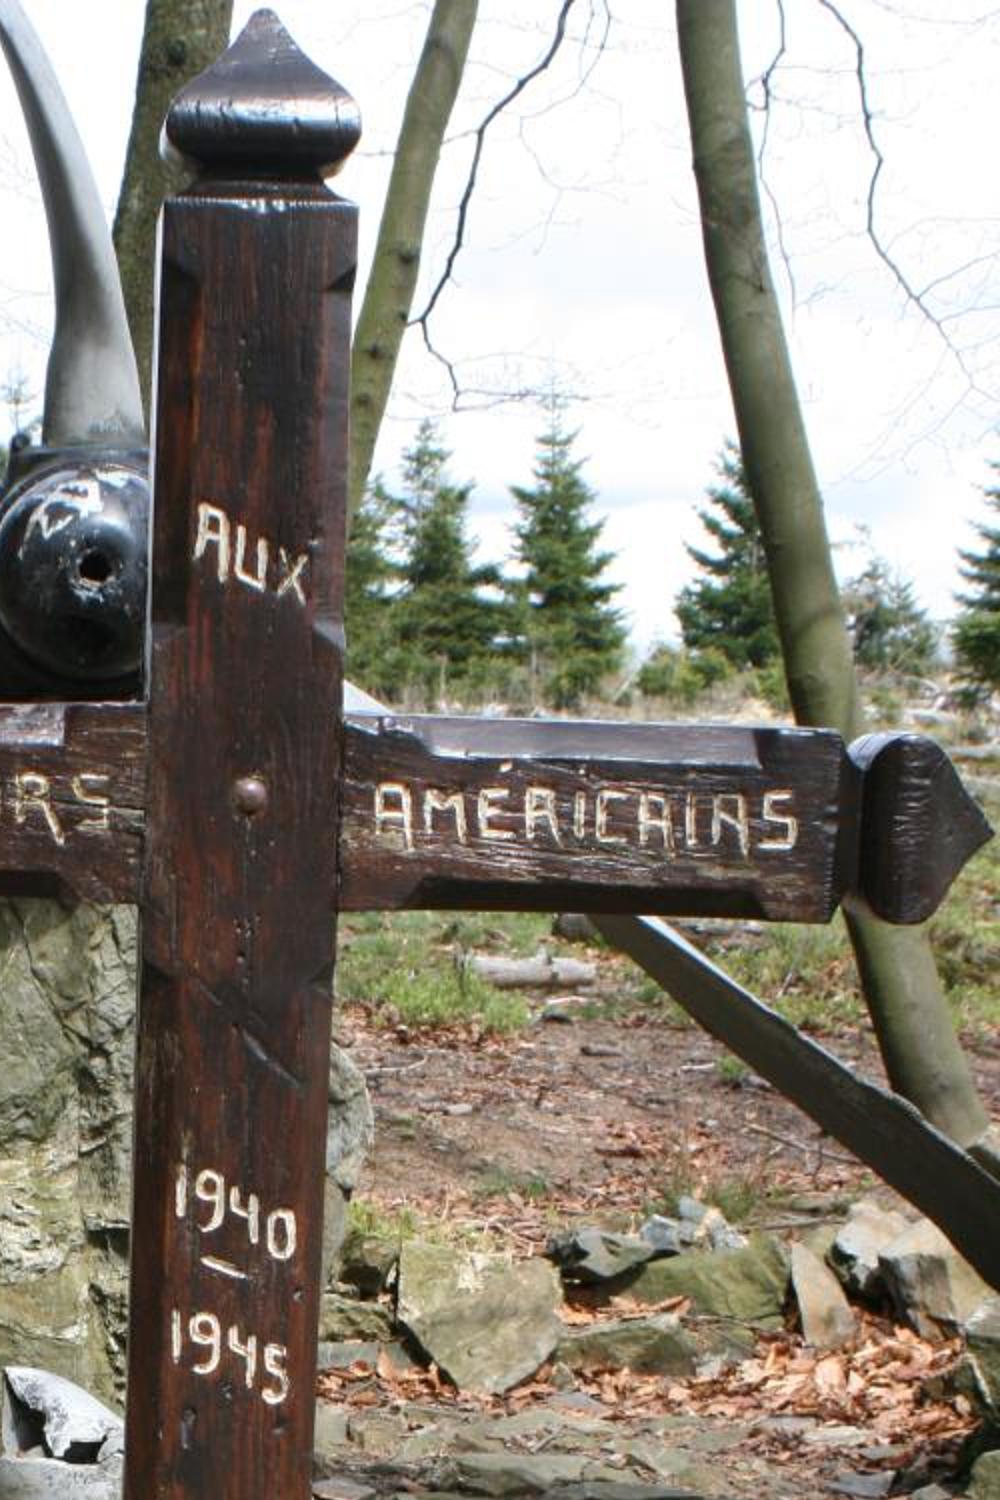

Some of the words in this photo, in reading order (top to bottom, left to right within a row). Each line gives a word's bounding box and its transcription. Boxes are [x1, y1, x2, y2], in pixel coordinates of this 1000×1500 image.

[192, 501, 309, 607] AUX
[175, 1162, 296, 1260] 1940
[171, 1308, 290, 1404] 1945
